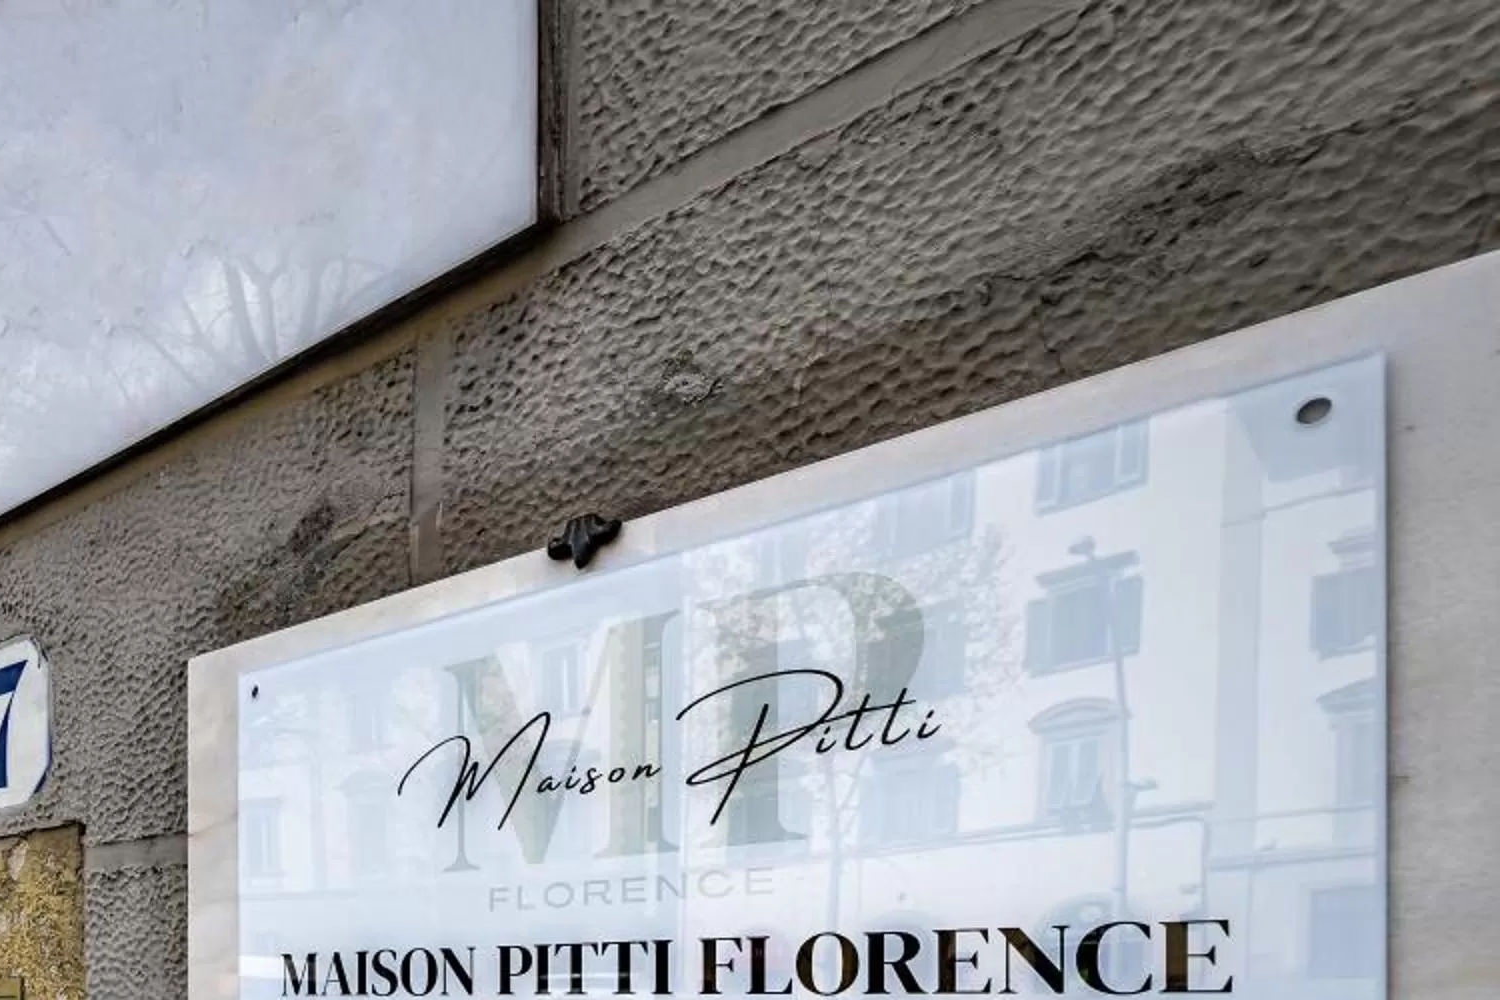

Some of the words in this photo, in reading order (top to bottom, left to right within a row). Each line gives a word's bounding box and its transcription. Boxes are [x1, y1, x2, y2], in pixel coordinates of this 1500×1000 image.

[397, 710, 662, 829] Maison
[675, 668, 942, 827] Pitti
[487, 866, 776, 913] FLORENCE
[281, 946, 476, 998] MAISON
[497, 938, 674, 996] PITTI
[699, 918, 1235, 997] FLORENCE
